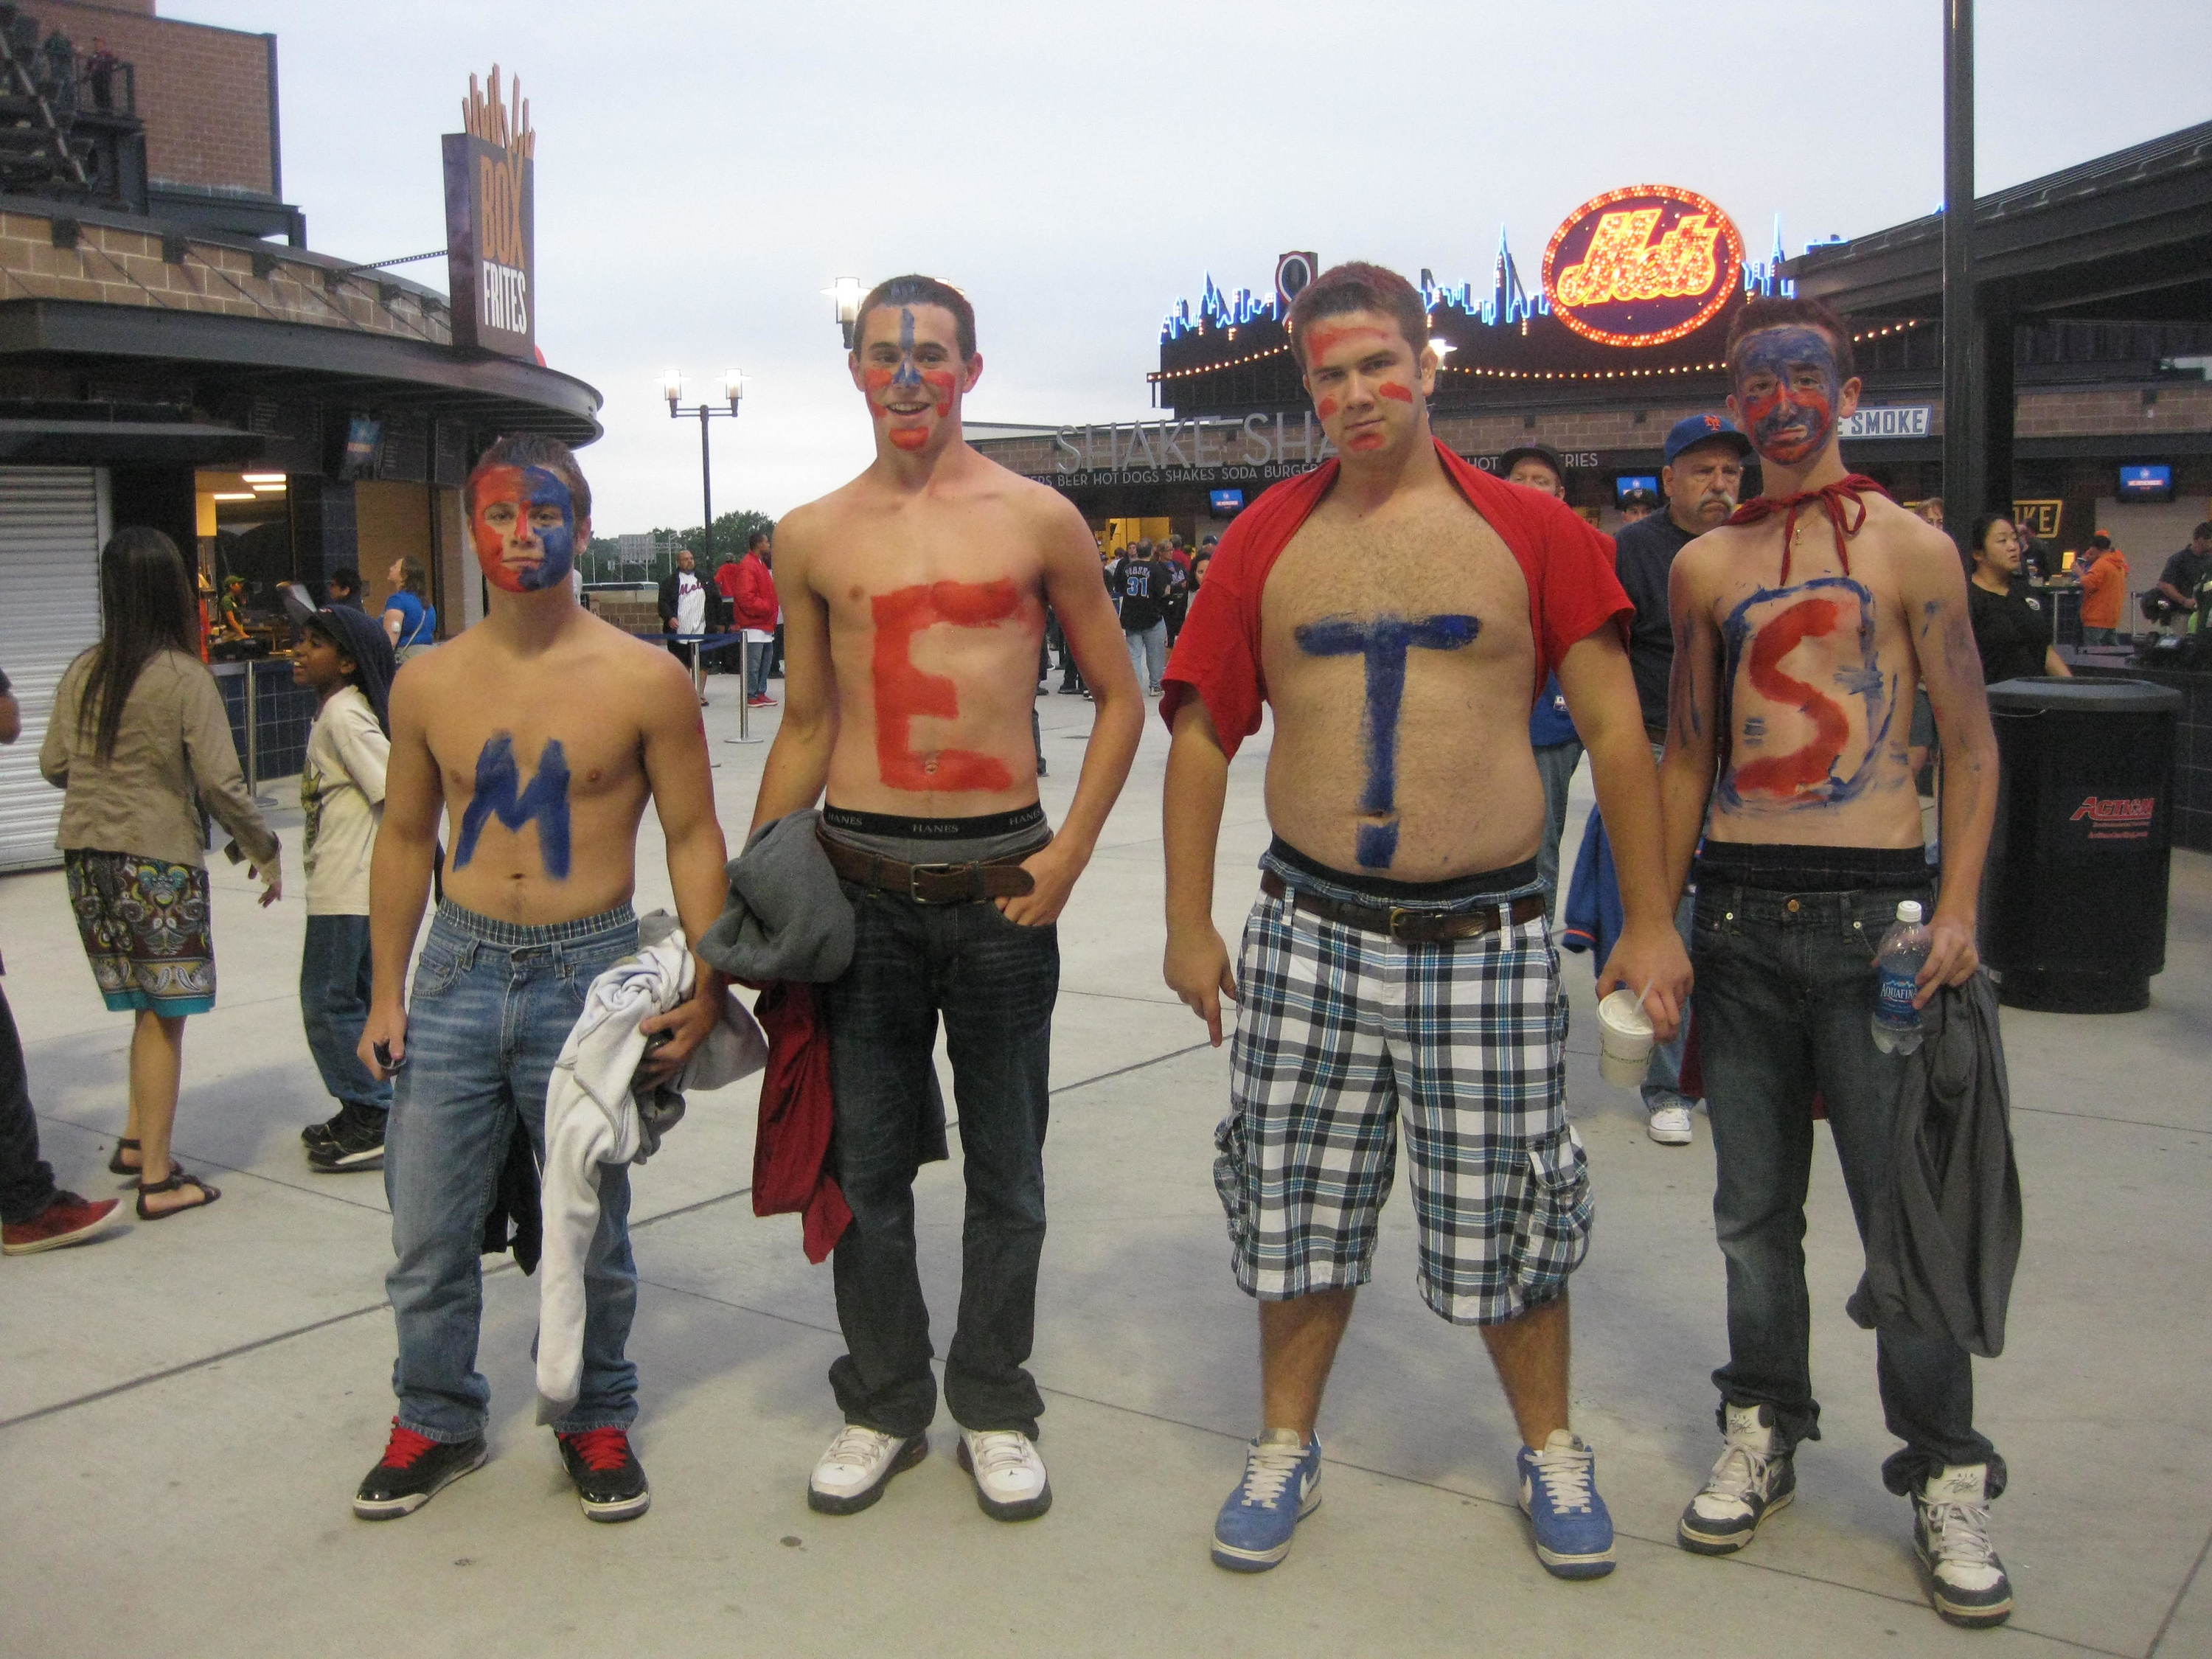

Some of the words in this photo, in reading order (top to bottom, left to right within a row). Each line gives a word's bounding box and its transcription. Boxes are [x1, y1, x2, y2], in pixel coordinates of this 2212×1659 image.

[479, 155, 525, 269] BOX
[483, 260, 528, 335] FRITES
[1057, 414, 1222, 475] SHAKE
[1851, 409, 1923, 435] SMOKE
[1057, 473, 1088, 487] BEER
[1093, 471, 1120, 485] HOT
[1122, 470, 1159, 484] DOGS
[1165, 467, 1215, 483] SHAKES
[1222, 466, 1258, 480] SODA
[1559, 452, 1599, 467] RIES
[1127, 576, 1148, 597] 31
[871, 577, 1019, 792] E
[1736, 598, 1849, 798] S
[1294, 613, 1482, 869] T
[452, 728, 571, 880] M
[912, 823, 959, 834] HANES
